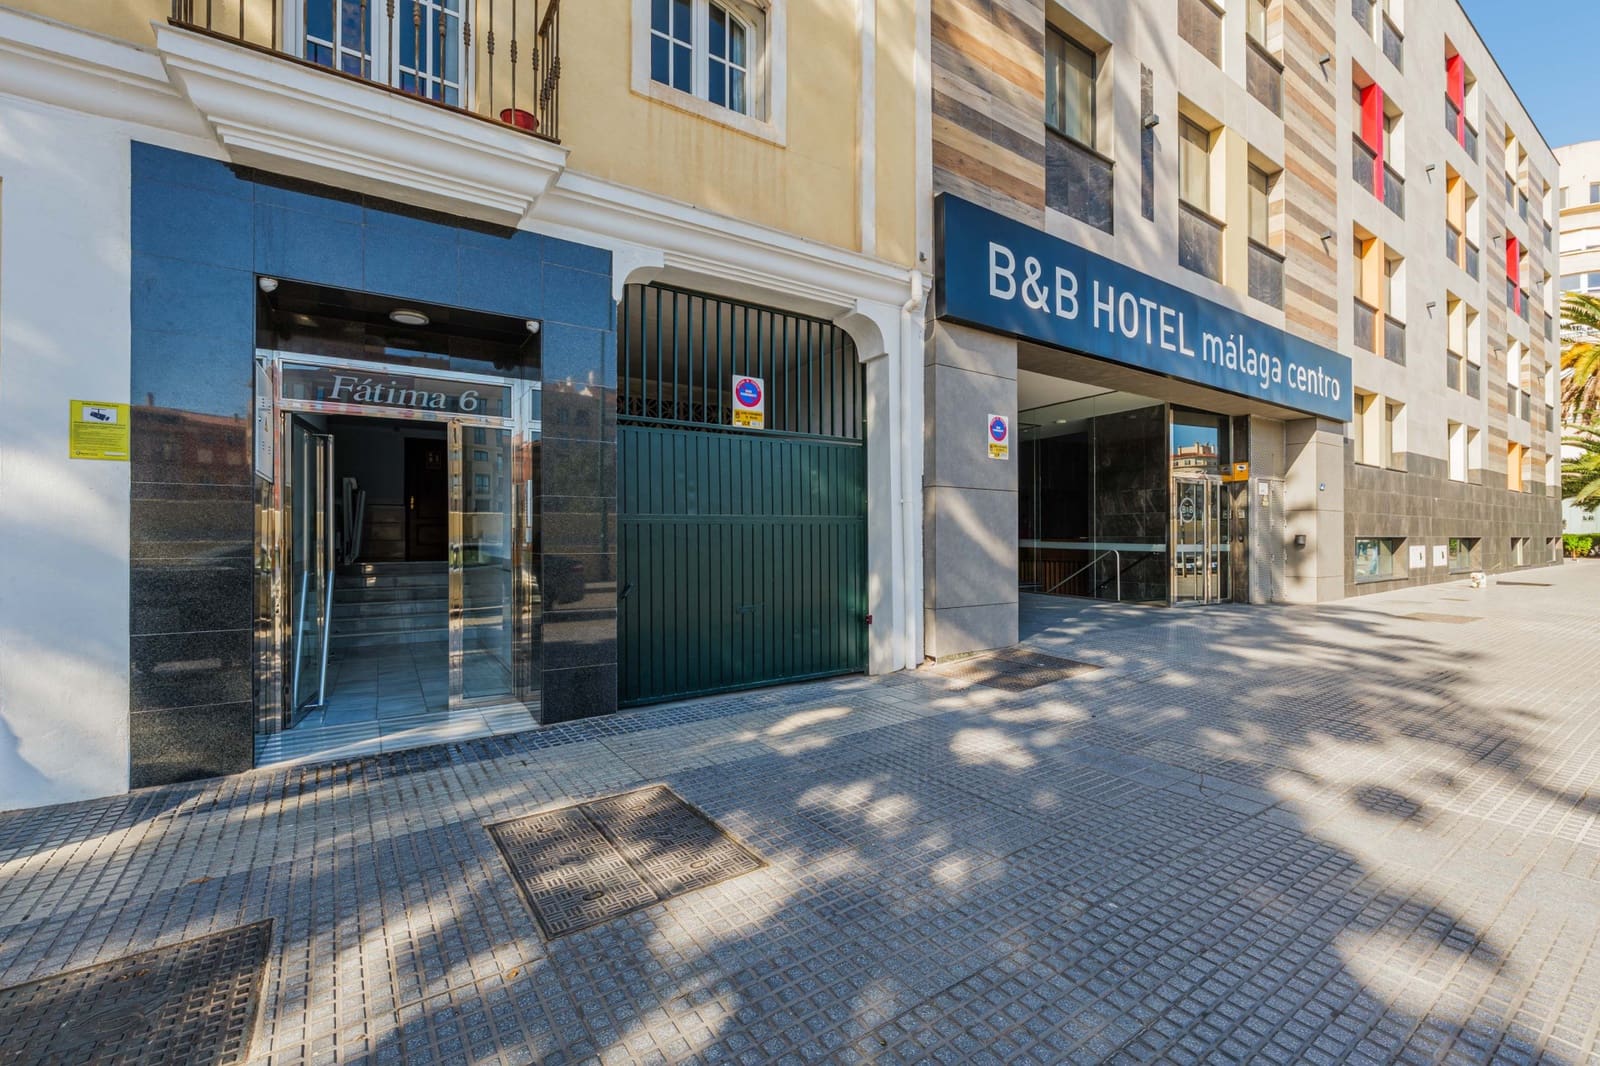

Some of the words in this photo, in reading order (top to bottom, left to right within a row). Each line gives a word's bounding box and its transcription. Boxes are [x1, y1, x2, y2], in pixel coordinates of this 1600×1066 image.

[988, 241, 1079, 321] B&B
[1093, 280, 1195, 357] HOTEL
[1203, 331, 1282, 389] málaga
[1287, 361, 1341, 402] centro
[327, 374, 447, 409] Fátima
[458, 390, 480, 412] 6
